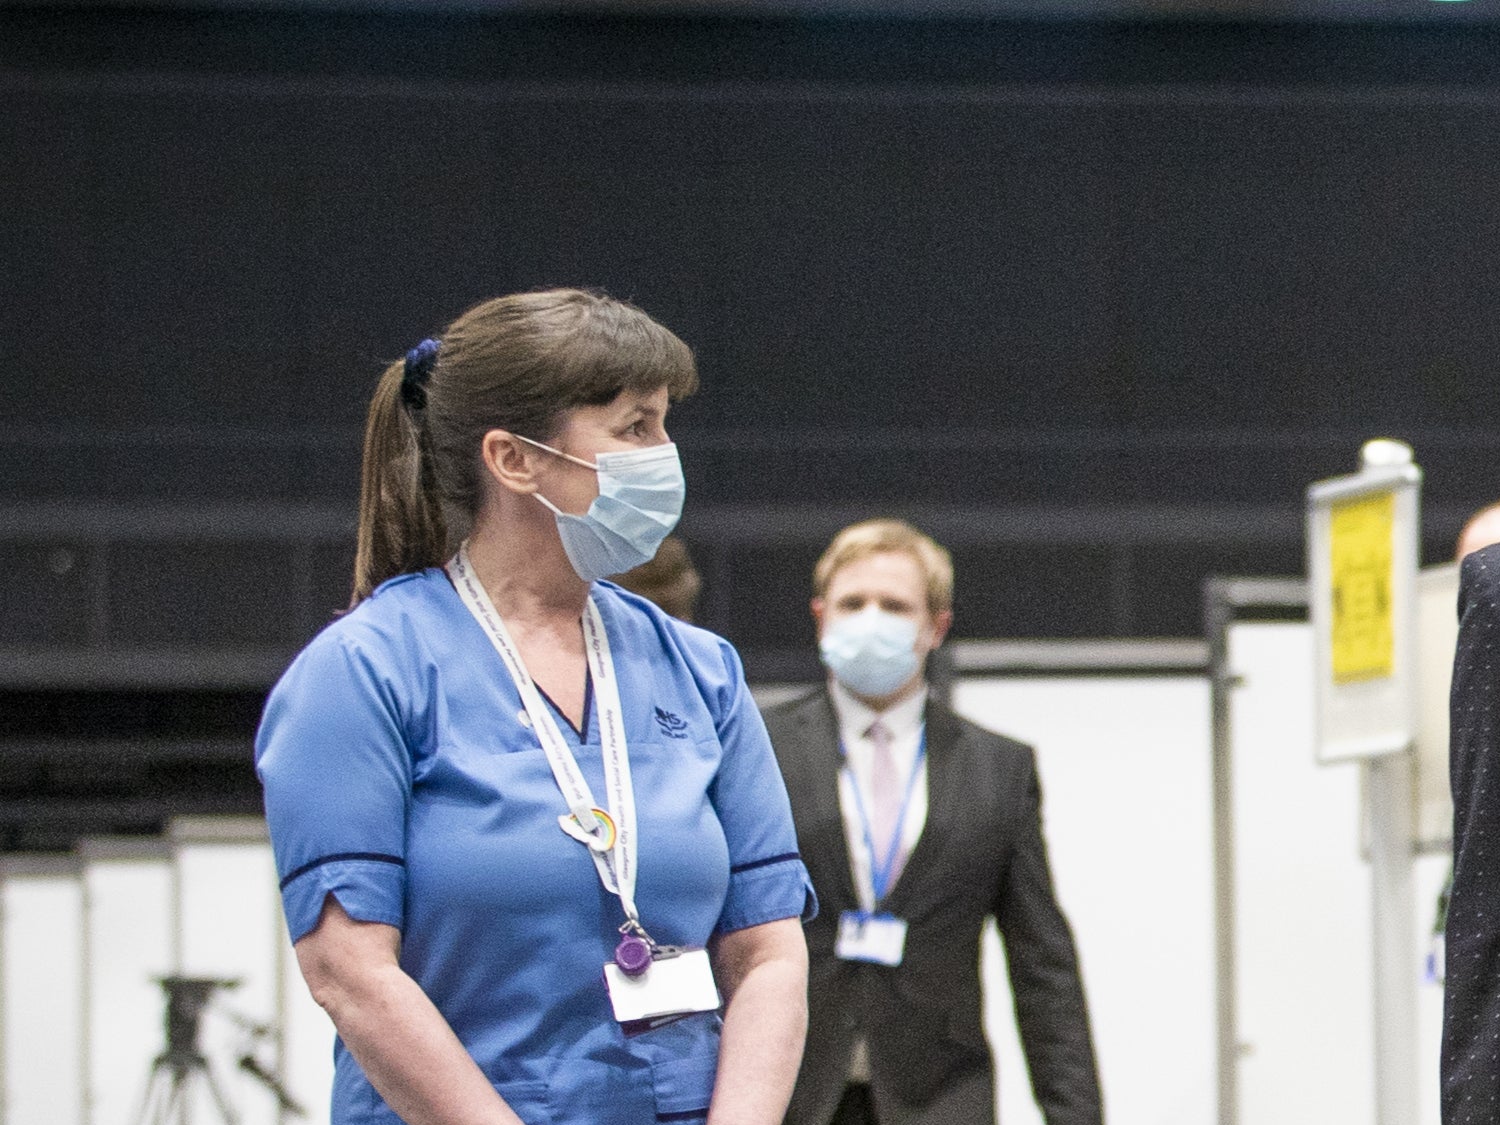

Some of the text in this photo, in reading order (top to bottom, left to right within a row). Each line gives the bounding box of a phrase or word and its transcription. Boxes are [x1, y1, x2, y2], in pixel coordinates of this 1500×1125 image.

[606, 708, 617, 748] Partnership
[619, 829, 629, 845] City
[622, 846, 631, 880] Glasgow
